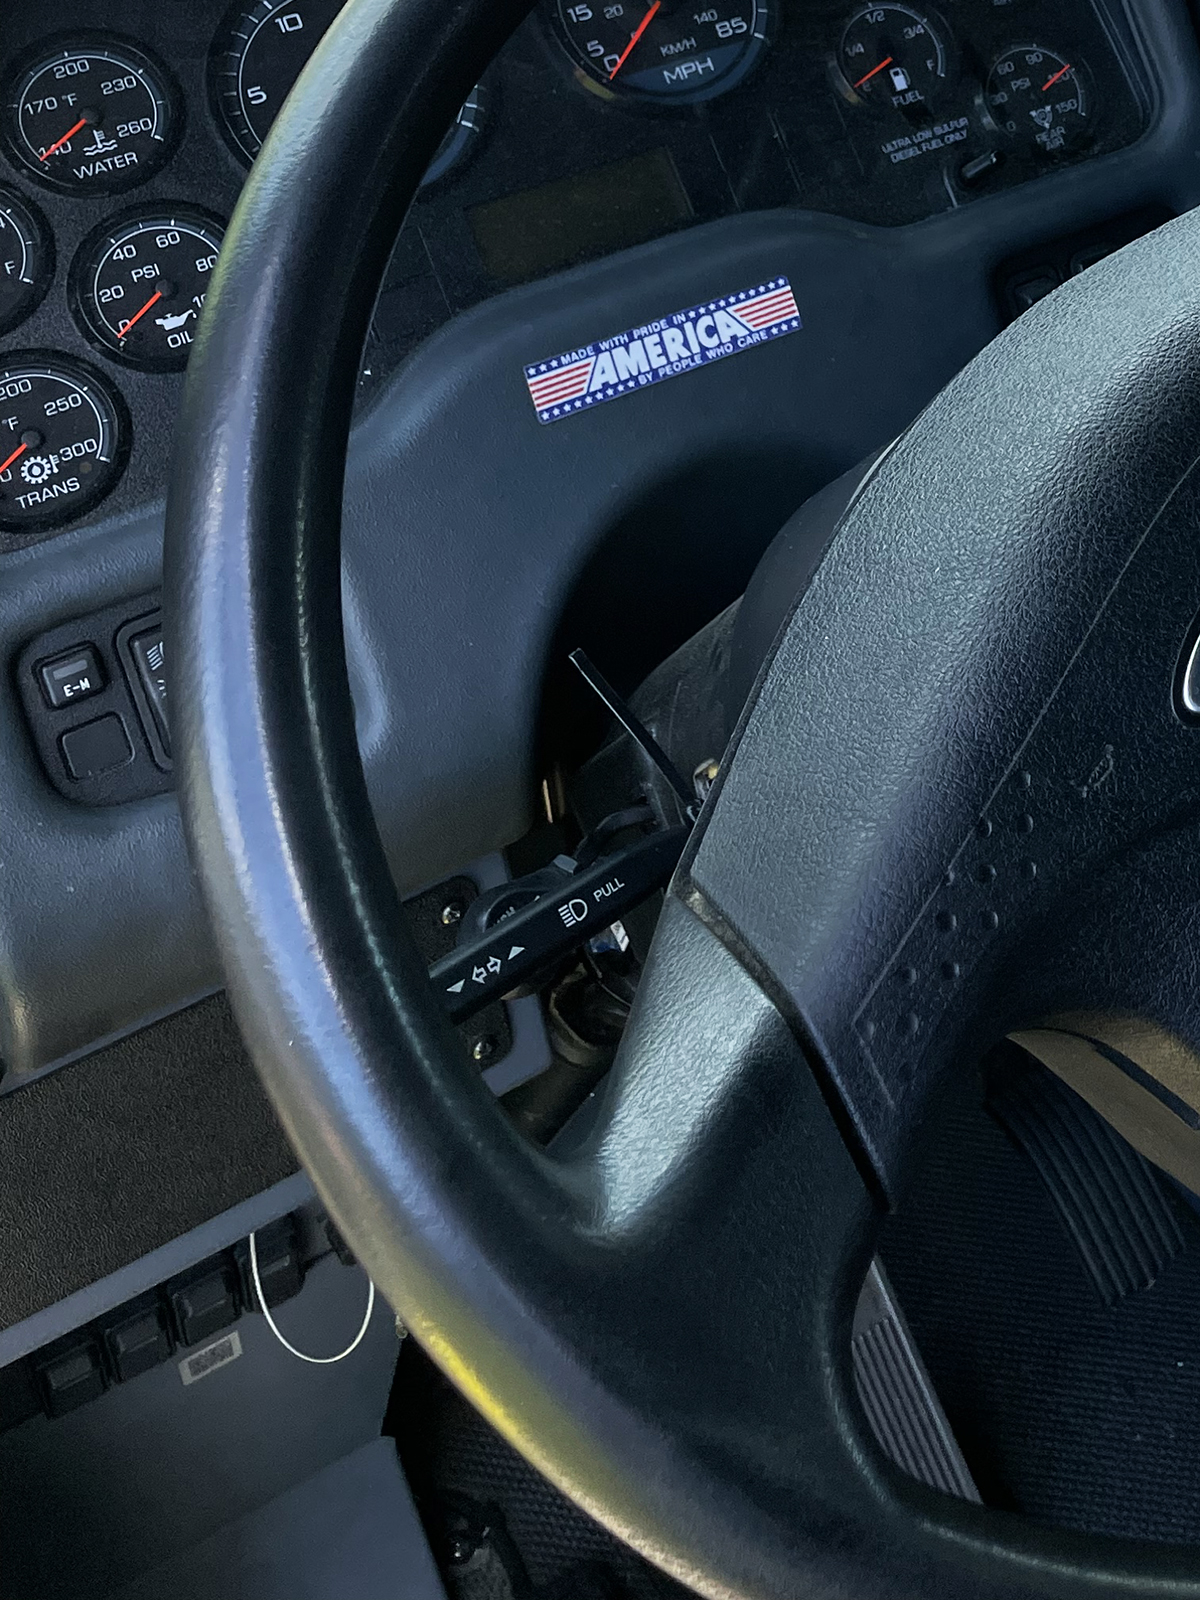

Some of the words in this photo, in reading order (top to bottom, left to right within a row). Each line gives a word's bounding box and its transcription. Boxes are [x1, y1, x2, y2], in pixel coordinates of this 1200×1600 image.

[566, 3, 594, 24] 15
[602, 3, 624, 20] 20
[693, 8, 719, 26] 140
[864, 9, 886, 25] 1/2
[274, 11, 304, 34] 10
[714, 16, 748, 40] 85
[903, 24, 925, 40] 3/4
[586, 39, 605, 59] 5
[844, 42, 866, 58] 1/4
[52, 58, 91, 80] 200
[661, 56, 715, 86] MPH
[925, 58, 935, 72] F
[100, 74, 138, 96] 230
[1010, 77, 1032, 92] PSI
[246, 85, 268, 105] 5
[890, 89, 925, 108] FUEL
[23, 96, 59, 115] 170
[1055, 98, 1078, 114] 150
[115, 116, 153, 139] 260
[881, 136, 912, 154] ULTRA
[912, 129, 933, 144] LOW
[920, 138, 945, 152] FUEL
[944, 128, 968, 145] ONLY
[72, 150, 139, 180] WATER
[155, 230, 182, 249] 60
[111, 243, 137, 262] 40
[3, 260, 16, 275] F
[130, 262, 162, 283] PSI
[194, 254, 218, 273] 80
[98, 284, 125, 304] 20
[166, 329, 194, 349] OIL
[559, 344, 595, 366] MADE
[598, 331, 629, 352] WITH
[633, 318, 668, 340] PRIDE
[672, 311, 687, 326] IN
[586, 309, 750, 394] AMERICA
[638, 370, 653, 386] BY
[658, 354, 703, 379] PEOPLE
[706, 342, 734, 360] WHO
[736, 329, 769, 348] CARE
[43, 392, 83, 417] 250
[58, 437, 98, 462] 300
[14, 476, 81, 510] TRANS
[592, 876, 626, 903] PULL
